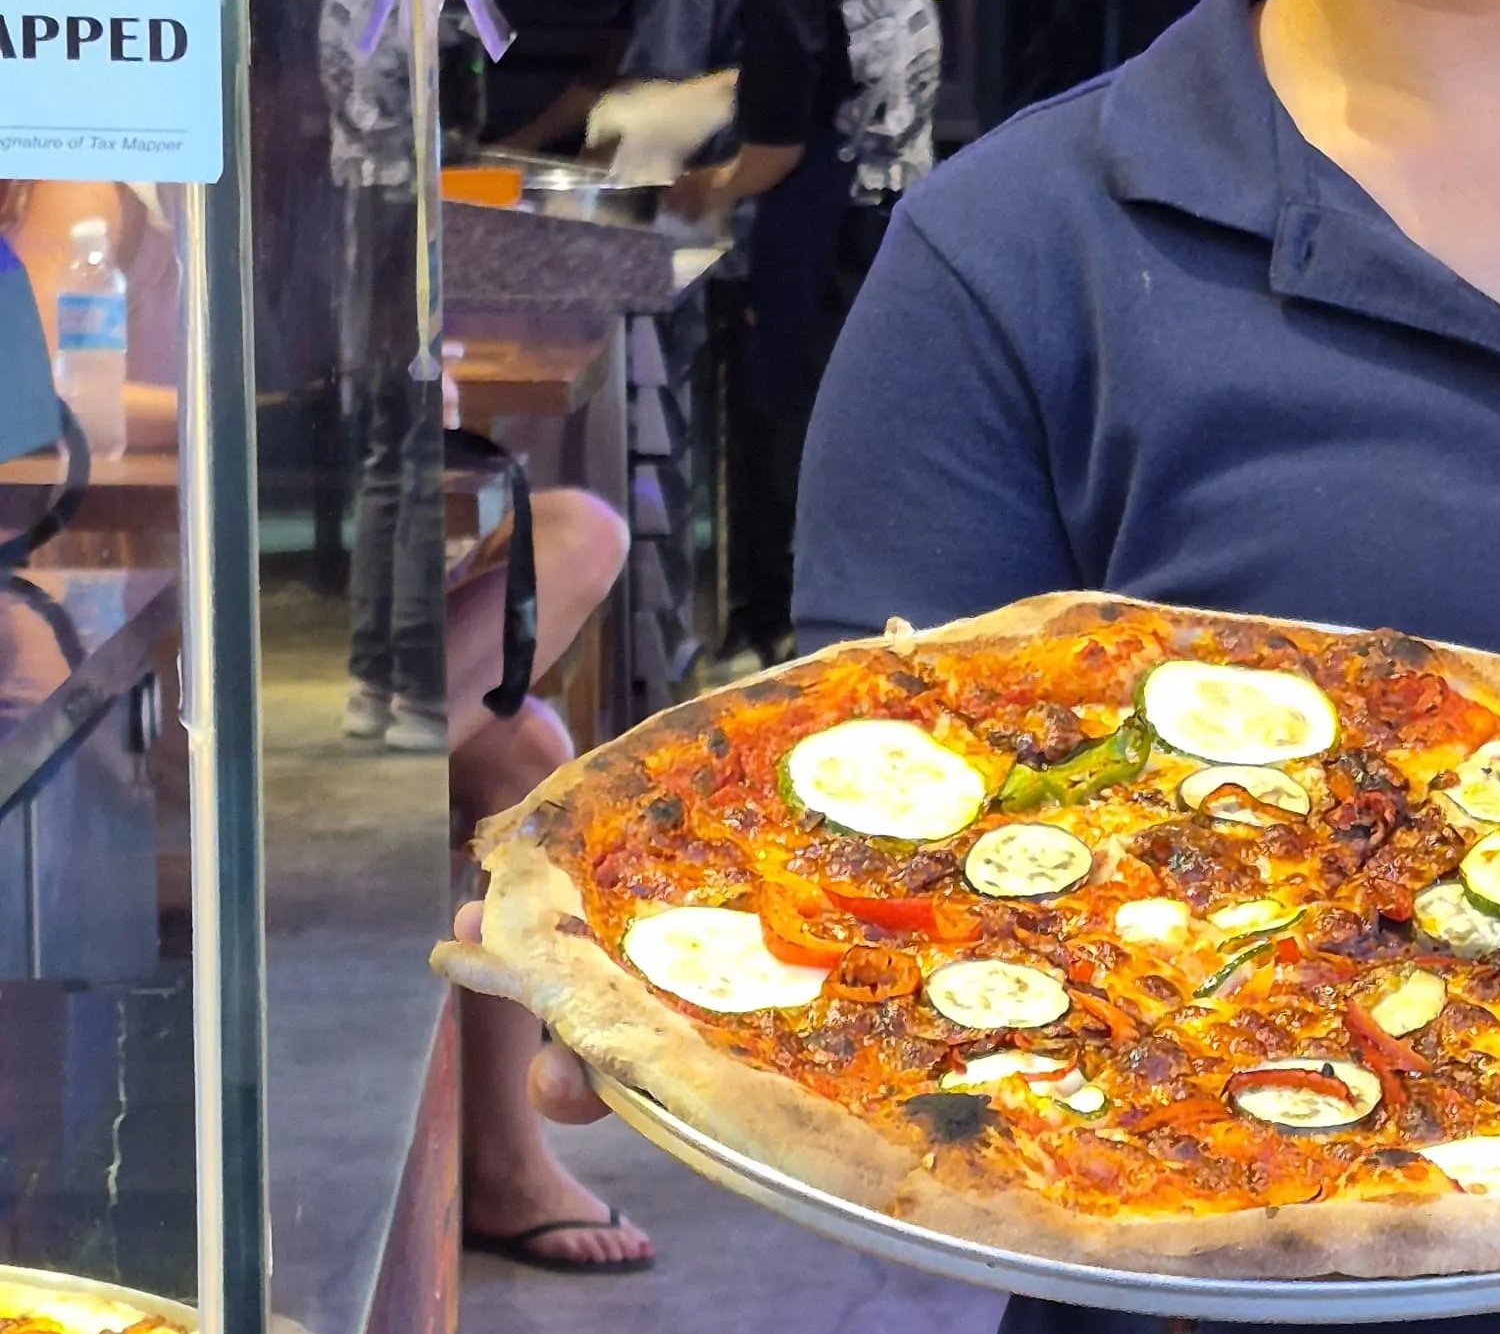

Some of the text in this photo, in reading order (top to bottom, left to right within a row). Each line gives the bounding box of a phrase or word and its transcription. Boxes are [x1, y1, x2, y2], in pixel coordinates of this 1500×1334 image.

[68, 136, 83, 150] of
[91, 136, 117, 150] Tax
[122, 137, 183, 153] Mapper
